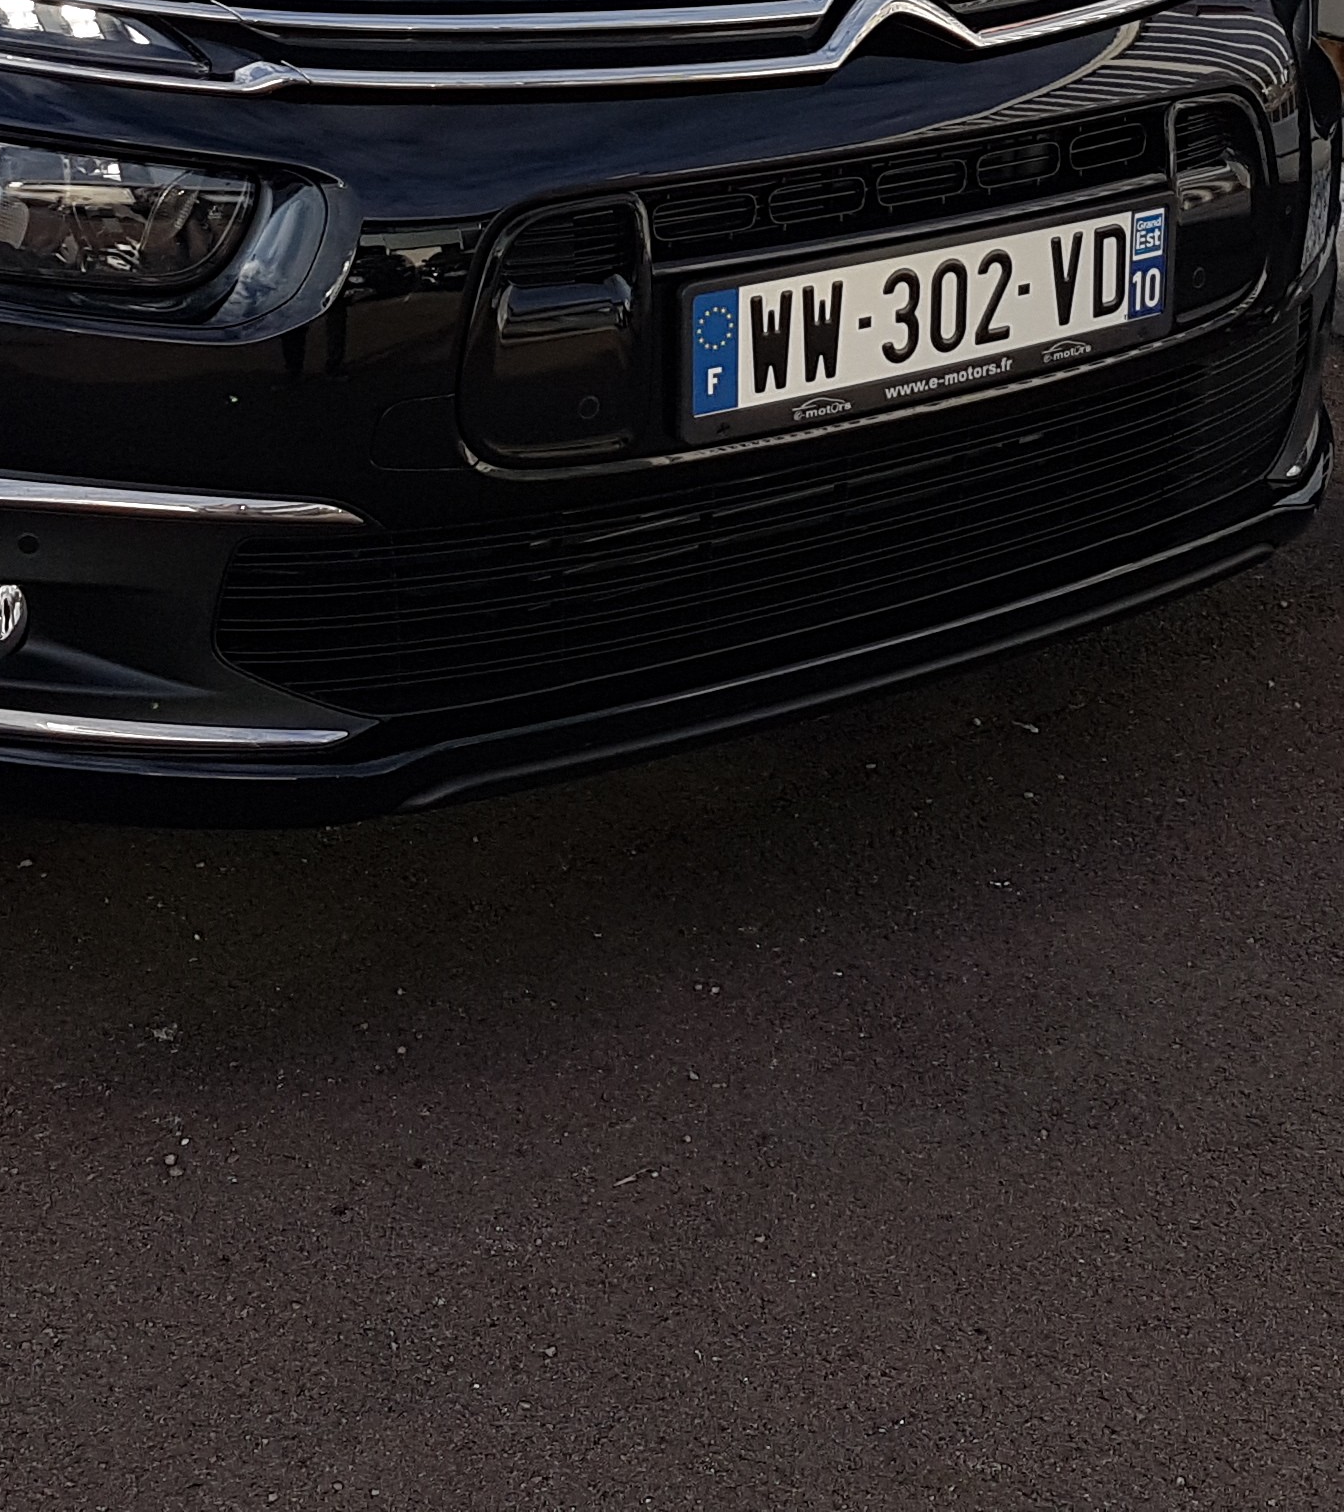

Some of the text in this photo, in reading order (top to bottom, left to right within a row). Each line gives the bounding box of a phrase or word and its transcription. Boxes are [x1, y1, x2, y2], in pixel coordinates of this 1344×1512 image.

[1137, 217, 1162, 231] Grand
[1136, 228, 1161, 250] Est
[1132, 267, 1161, 311] 10
[707, 366, 723, 395] F
[885, 356, 1013, 400] www.e-motors.fr
